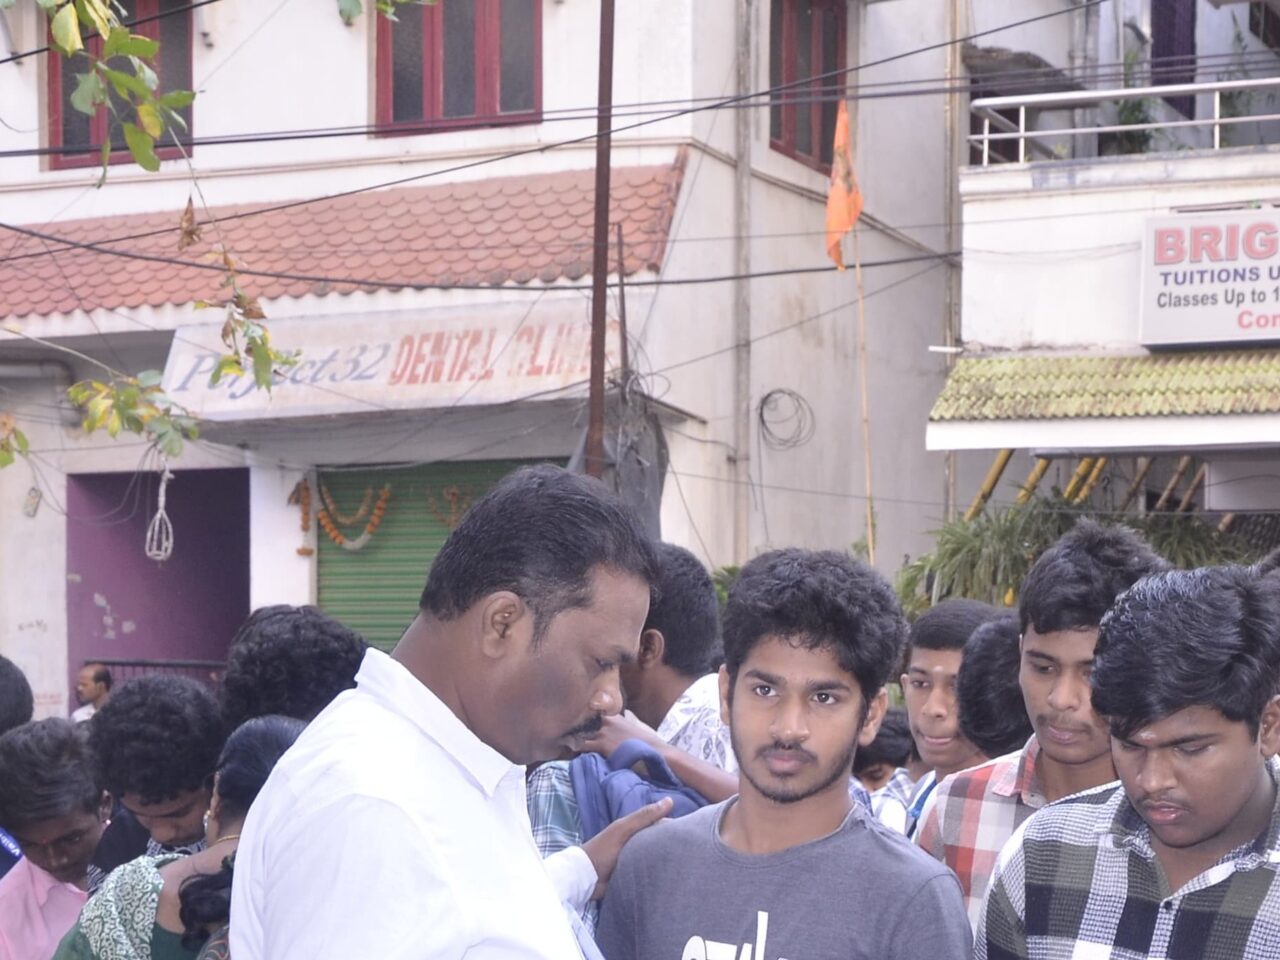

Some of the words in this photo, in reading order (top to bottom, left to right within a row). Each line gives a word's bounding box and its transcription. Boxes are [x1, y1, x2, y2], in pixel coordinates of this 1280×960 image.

[1160, 267, 1260, 287] TUITIONS
[1157, 291, 1218, 308] Classes
[1224, 288, 1245, 308] Up
[1251, 288, 1266, 303] to
